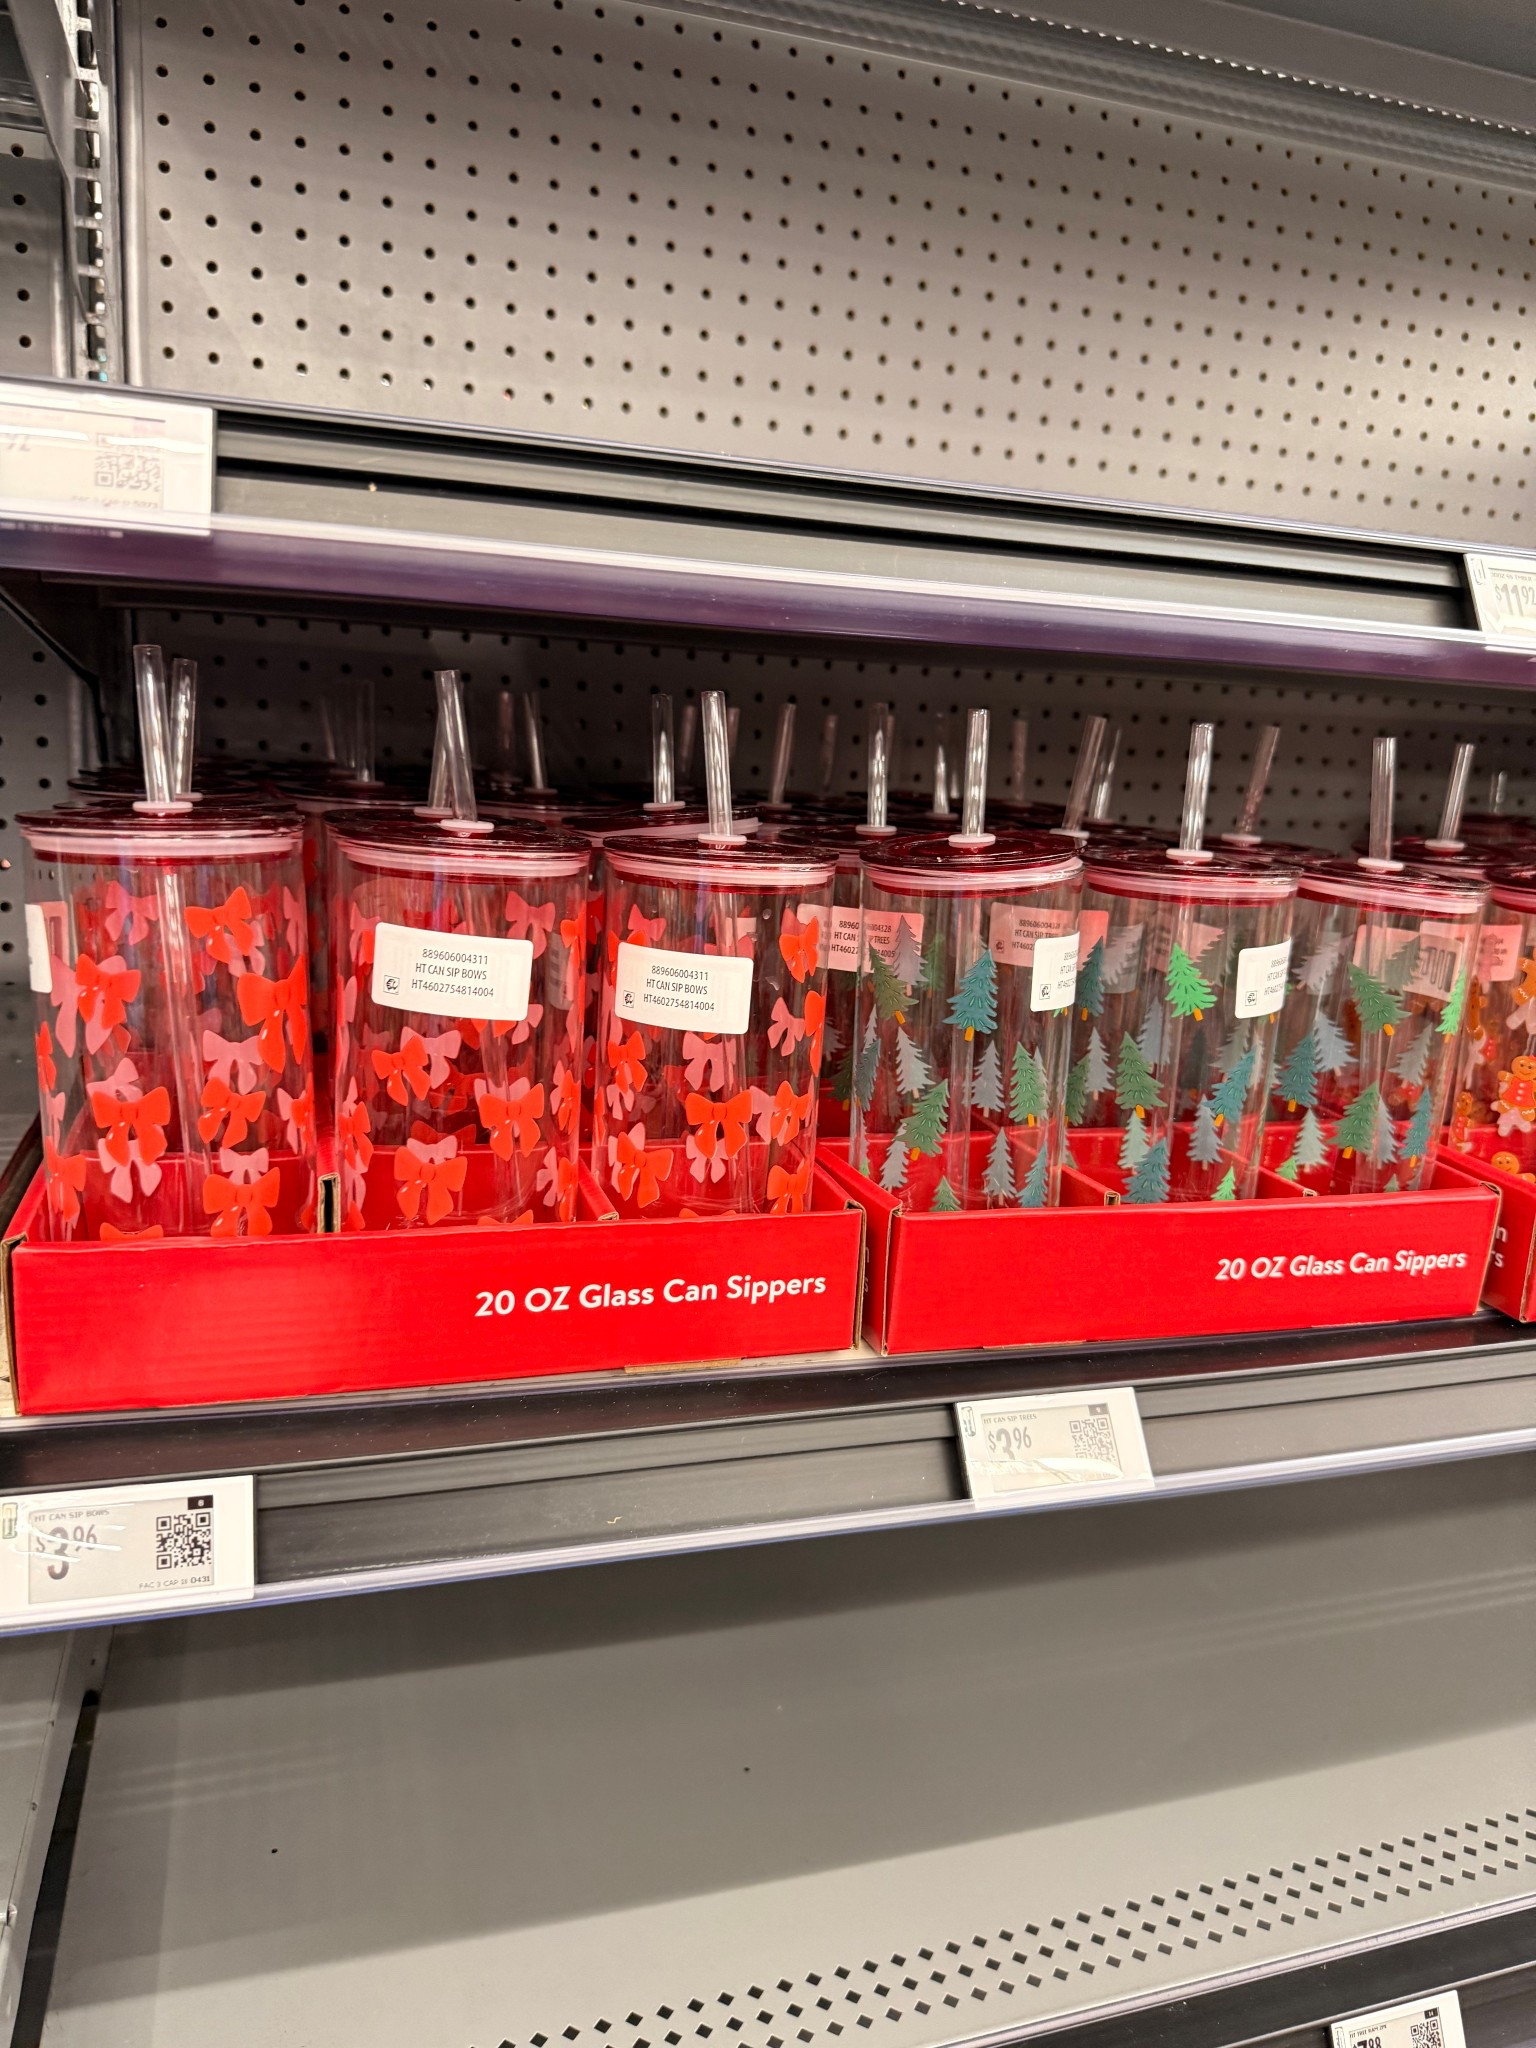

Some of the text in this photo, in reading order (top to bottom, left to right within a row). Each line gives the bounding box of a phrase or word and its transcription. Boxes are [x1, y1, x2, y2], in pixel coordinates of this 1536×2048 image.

[834, 931, 842, 940] HT
[843, 932, 856, 942] CAN
[1014, 929, 1023, 937] HT
[1022, 930, 1034, 939] CAN
[422, 948, 488, 965] 889606004311
[415, 962, 487, 980] HT CAN SIP BOWS
[651, 965, 709, 981] 889606004311
[411, 978, 494, 997] HT4602754814004
[646, 978, 708, 995] HT CAN SIP BOWS
[643, 993, 715, 1011] HT4602754814004
[1215, 1258, 1246, 1281] 20
[1250, 1256, 1286, 1279] OZ
[1289, 1254, 1345, 1277] Glass
[1350, 1252, 1389, 1274] Can
[1393, 1249, 1467, 1277] Sippers
[474, 1274, 826, 1317] 20 OZ Glass Can Sippers
[983, 1417, 992, 1425] HT
[993, 1416, 1006, 1424] CAN
[1019, 1413, 1037, 1421] TREES
[34, 1509, 110, 1523] HT CAN SIP BOWS
